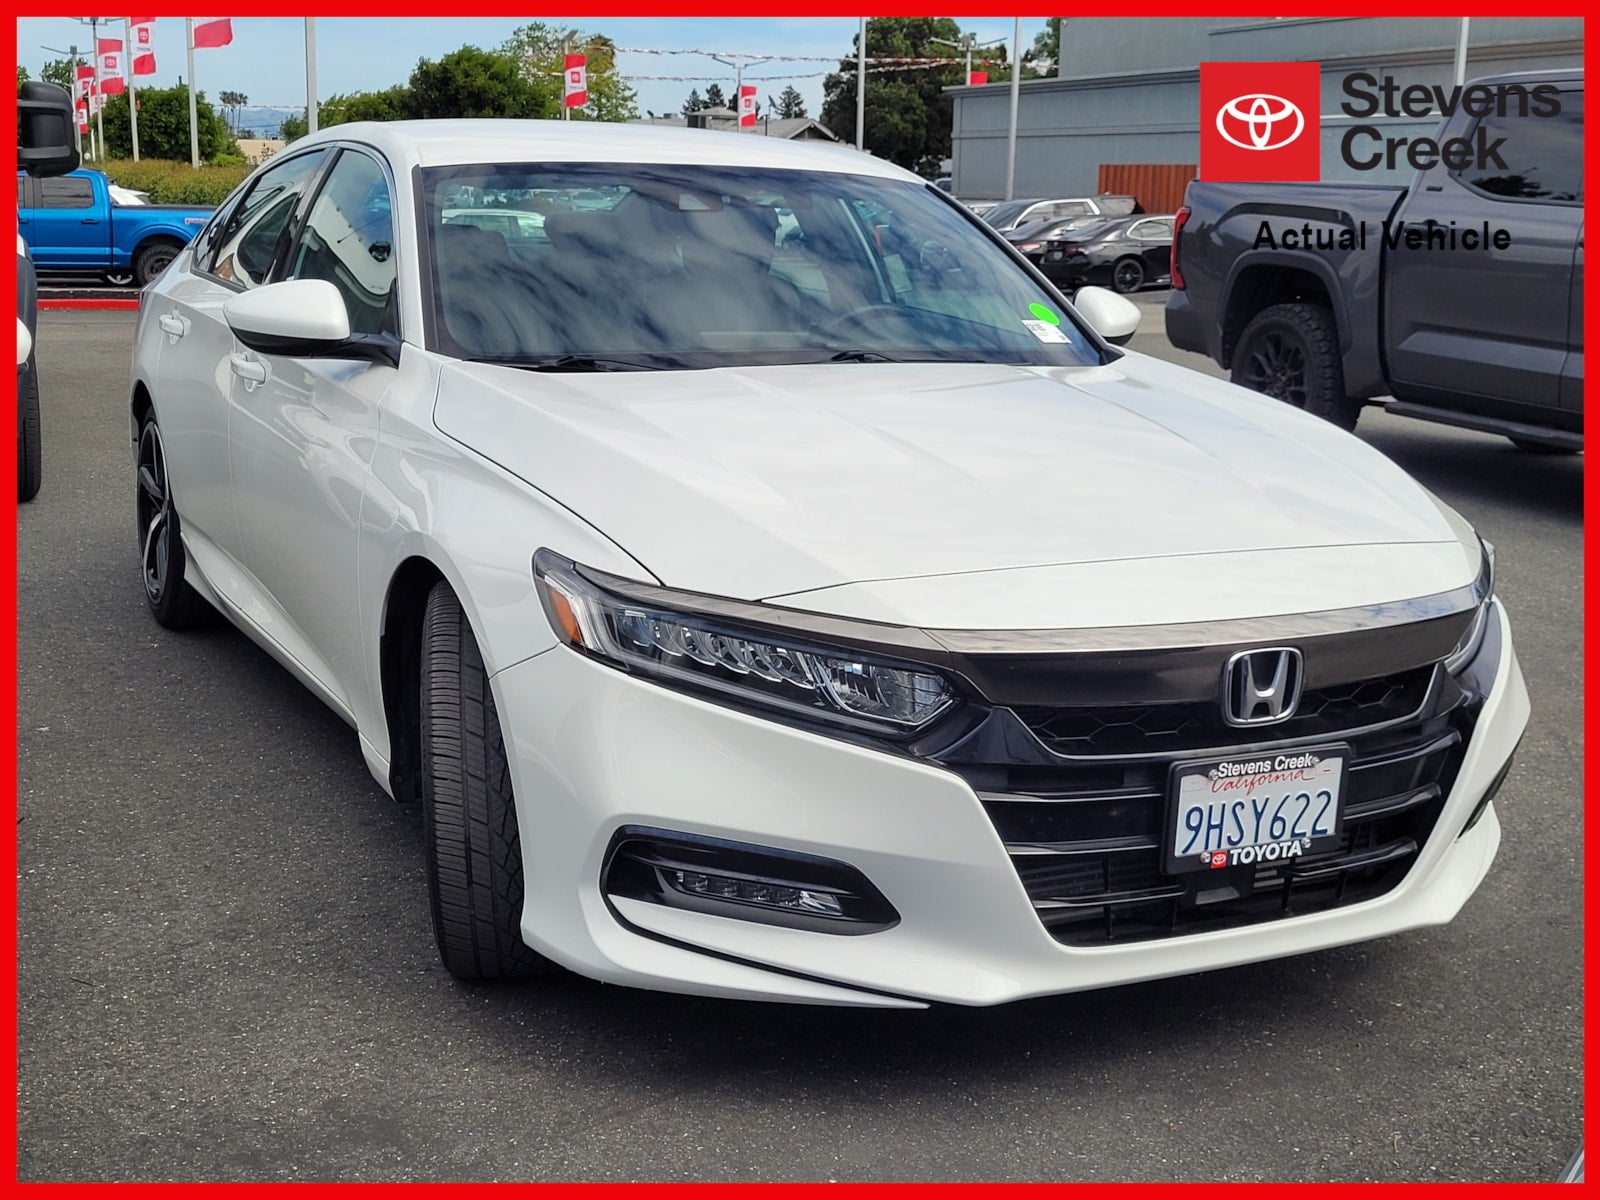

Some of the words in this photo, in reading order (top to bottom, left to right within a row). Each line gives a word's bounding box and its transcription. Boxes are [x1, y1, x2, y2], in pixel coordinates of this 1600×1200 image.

[1217, 760, 1271, 778] Stevens
[1274, 752, 1314, 771] Creek
[1211, 768, 1315, 796] California
[1181, 789, 1332, 855] 9HSY622
[1229, 840, 1303, 866] TOYOTA
